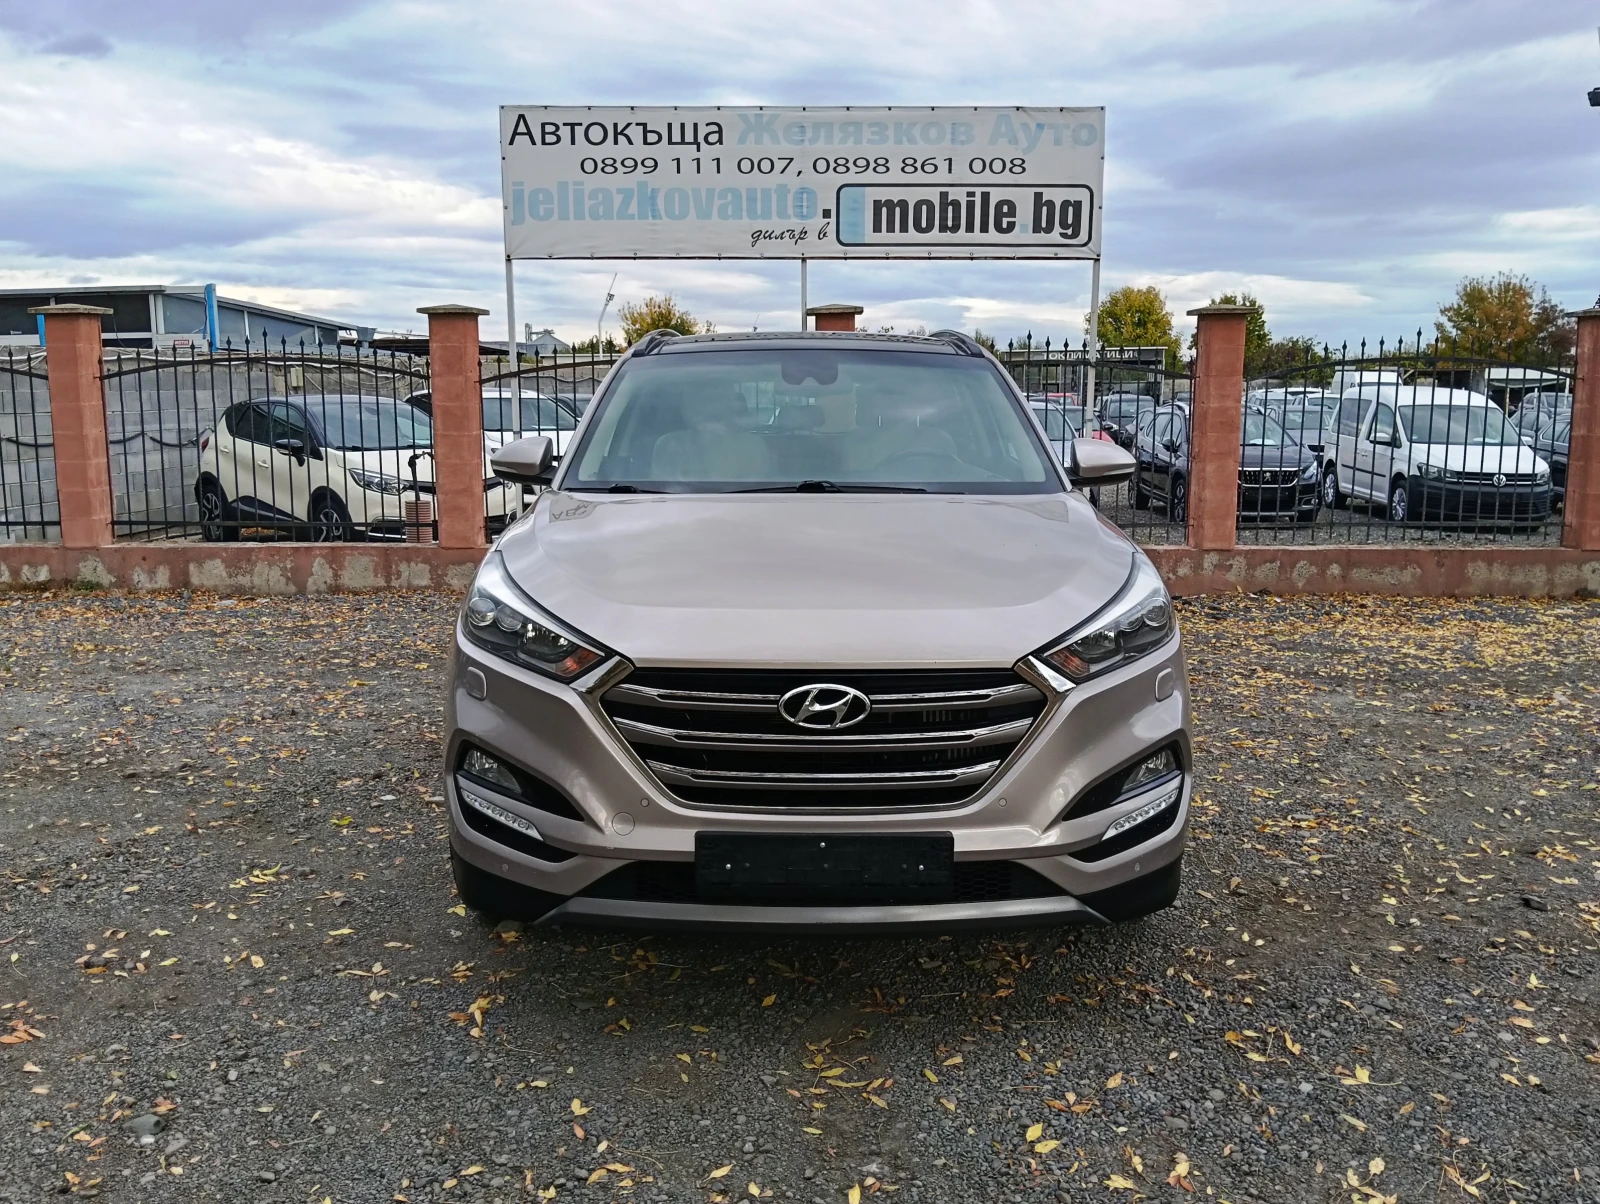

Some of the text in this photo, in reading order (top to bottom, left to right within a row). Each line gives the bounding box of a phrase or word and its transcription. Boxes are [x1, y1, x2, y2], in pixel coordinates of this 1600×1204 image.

[508, 113, 1099, 155] Автокъща Желязков Ауто
[580, 156, 1027, 178] 0899 111 007, 0898 861 008
[872, 191, 1083, 239] mobile.bg
[751, 226, 809, 248] дилър
